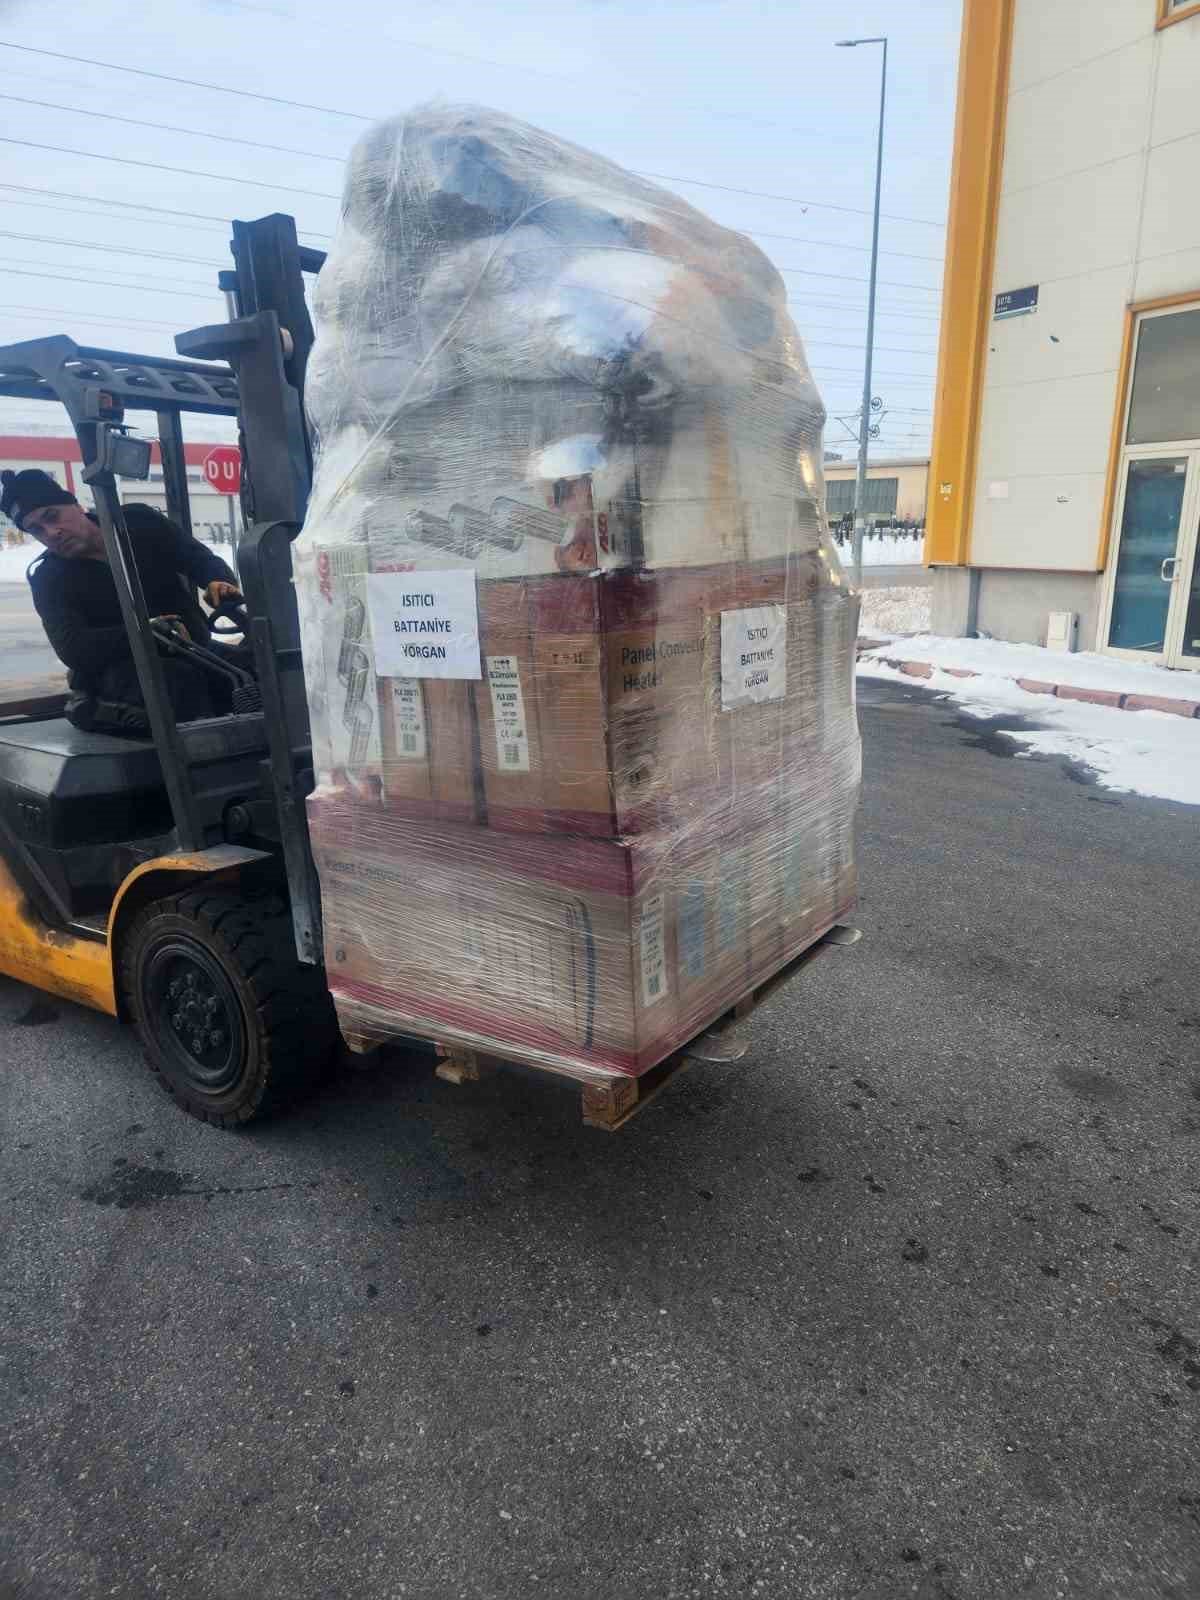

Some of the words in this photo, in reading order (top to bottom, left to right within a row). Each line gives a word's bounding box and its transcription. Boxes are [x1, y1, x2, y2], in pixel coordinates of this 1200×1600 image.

[208, 459, 240, 480] DU
[402, 594, 434, 607] ISITICI
[393, 618, 452, 633] BATTANİYE
[402, 645, 446, 658] YORGAN
[622, 642, 656, 664] Panel
